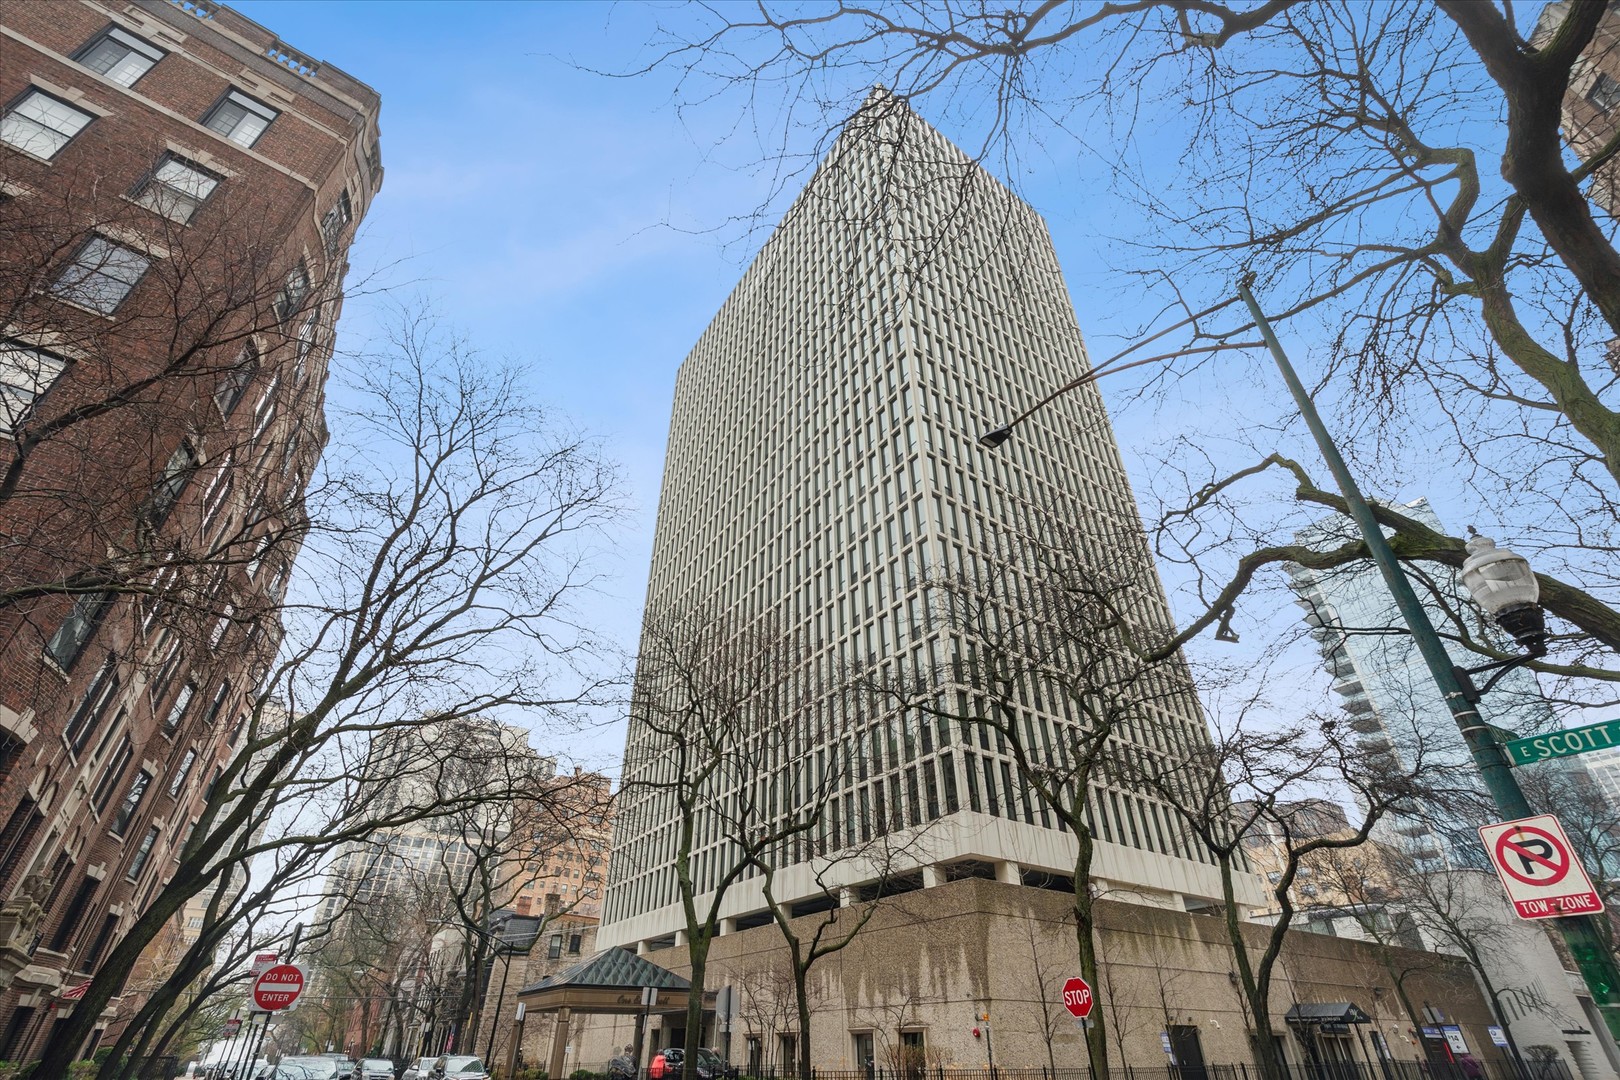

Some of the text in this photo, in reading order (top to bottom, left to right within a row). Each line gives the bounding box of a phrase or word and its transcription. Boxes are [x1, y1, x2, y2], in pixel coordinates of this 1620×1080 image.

[1520, 725, 1613, 757] E SCOTT
[265, 973, 278, 981] DO
[280, 973, 300, 982] NOT
[261, 993, 289, 1002] ENTER
[1064, 989, 1090, 1006] STOP
